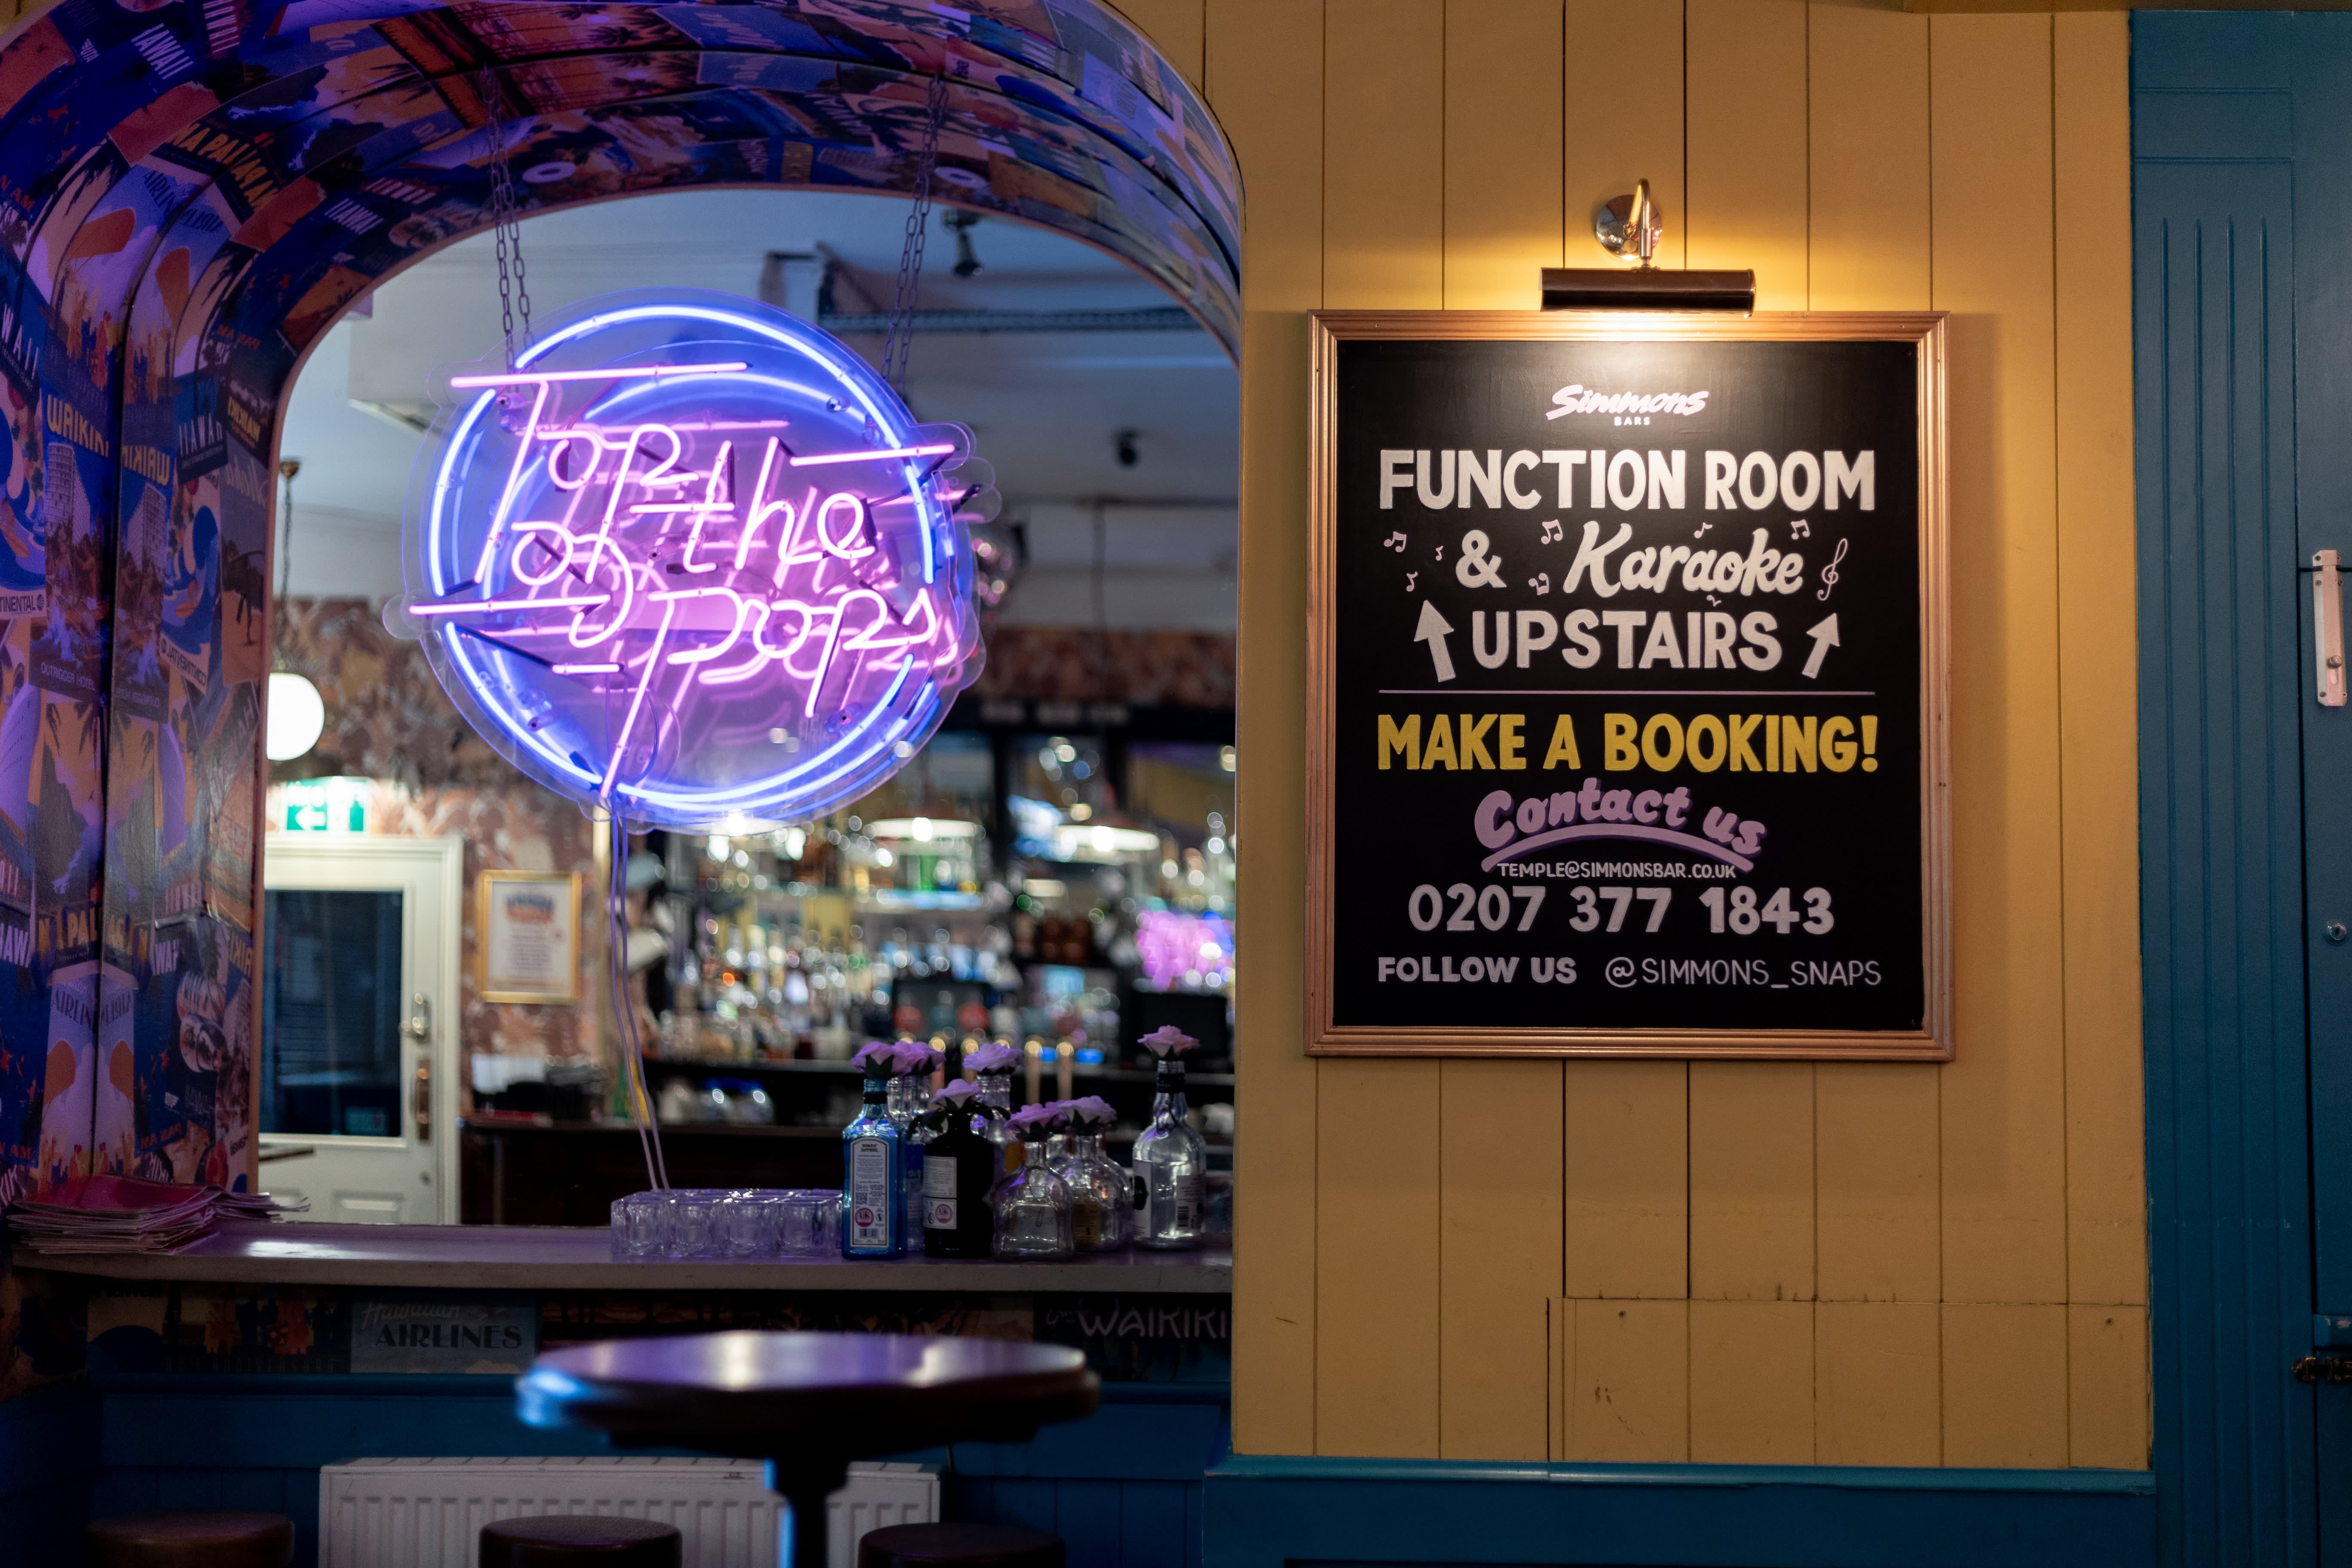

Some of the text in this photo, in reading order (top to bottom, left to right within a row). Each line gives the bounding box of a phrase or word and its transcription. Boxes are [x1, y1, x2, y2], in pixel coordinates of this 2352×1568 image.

[1545, 383, 1710, 421] Simmons
[1614, 416, 1651, 426] BARS
[1380, 448, 1876, 512] FUNCTION ROOM
[1456, 520, 1804, 598] & Karaoke
[1473, 609, 1782, 671] UPSTAIRS
[1378, 714, 1877, 772] MAKE A BOOKING!
[1474, 777, 1767, 855] Contact us
[1497, 861, 1736, 879] TEMPLE@SIMMONSBAR.CO.UK
[1409, 883, 1834, 934] 0207 377 1843
[1379, 957, 1881, 988] FOLLOW US @SIMMONS_SNAPS
[375, 1323, 523, 1349] AIRLINES
[1076, 1295, 1228, 1339] WAIKIKI
